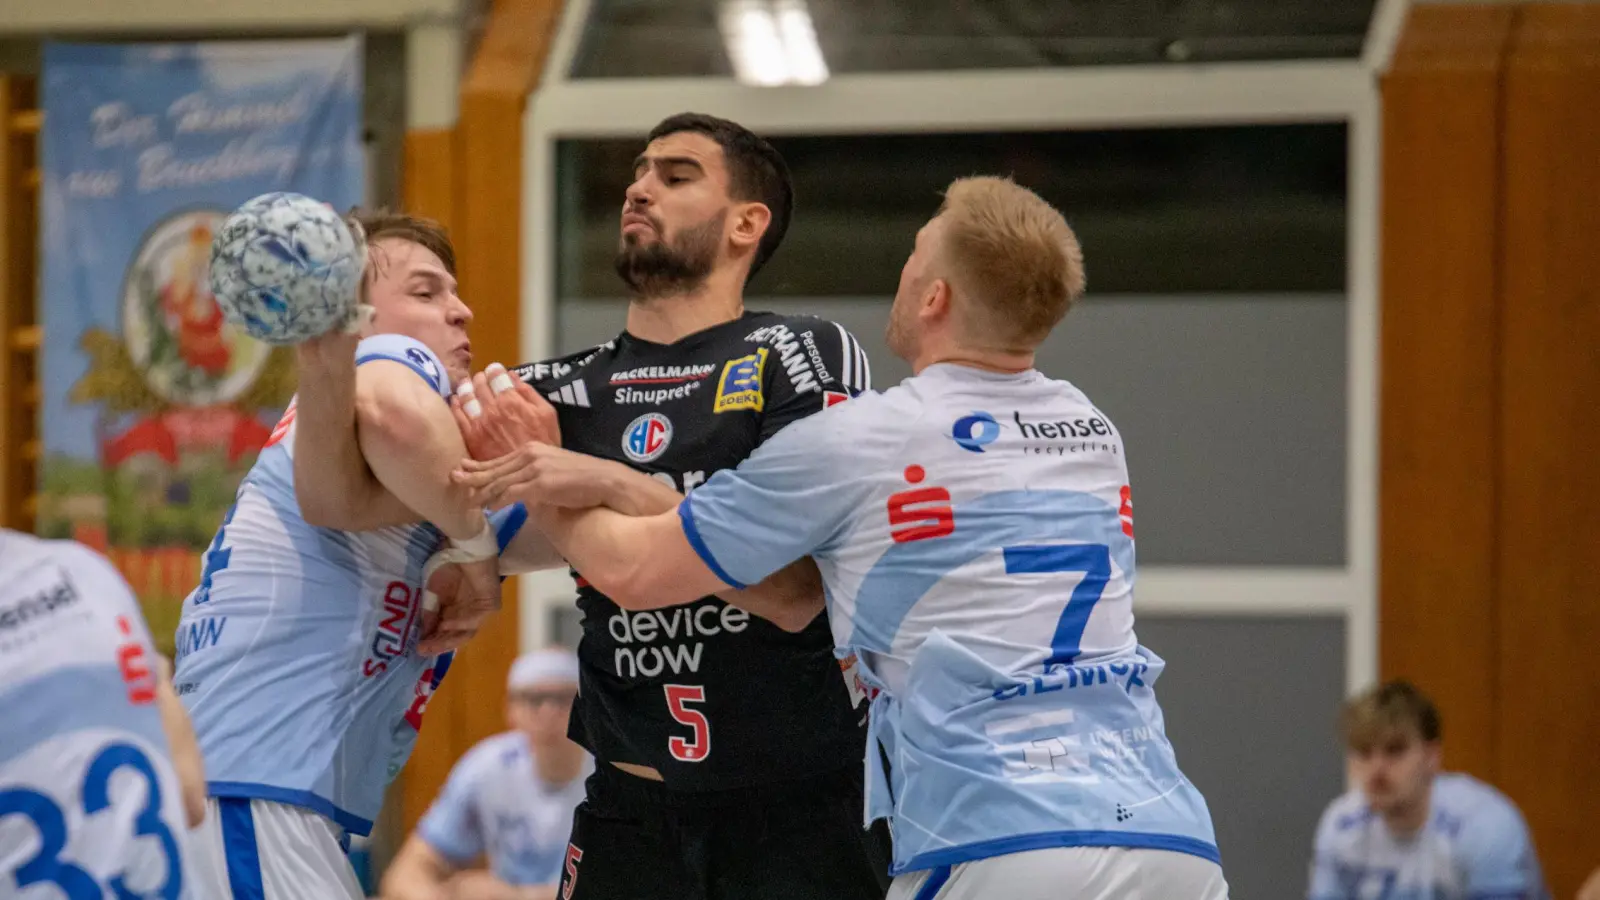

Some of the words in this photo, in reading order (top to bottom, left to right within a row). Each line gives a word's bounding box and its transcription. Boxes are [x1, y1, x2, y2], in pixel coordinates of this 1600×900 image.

[610, 363, 717, 381] FACKELMANN
[800, 330, 835, 383] Personal
[1013, 408, 1113, 439] hensel
[1023, 441, 1118, 456] recycling
[608, 604, 749, 644] device
[1004, 544, 1112, 666] 7
[614, 642, 704, 678] now
[663, 683, 712, 763] 5
[0, 743, 182, 900] 33
[562, 842, 584, 900] 5
